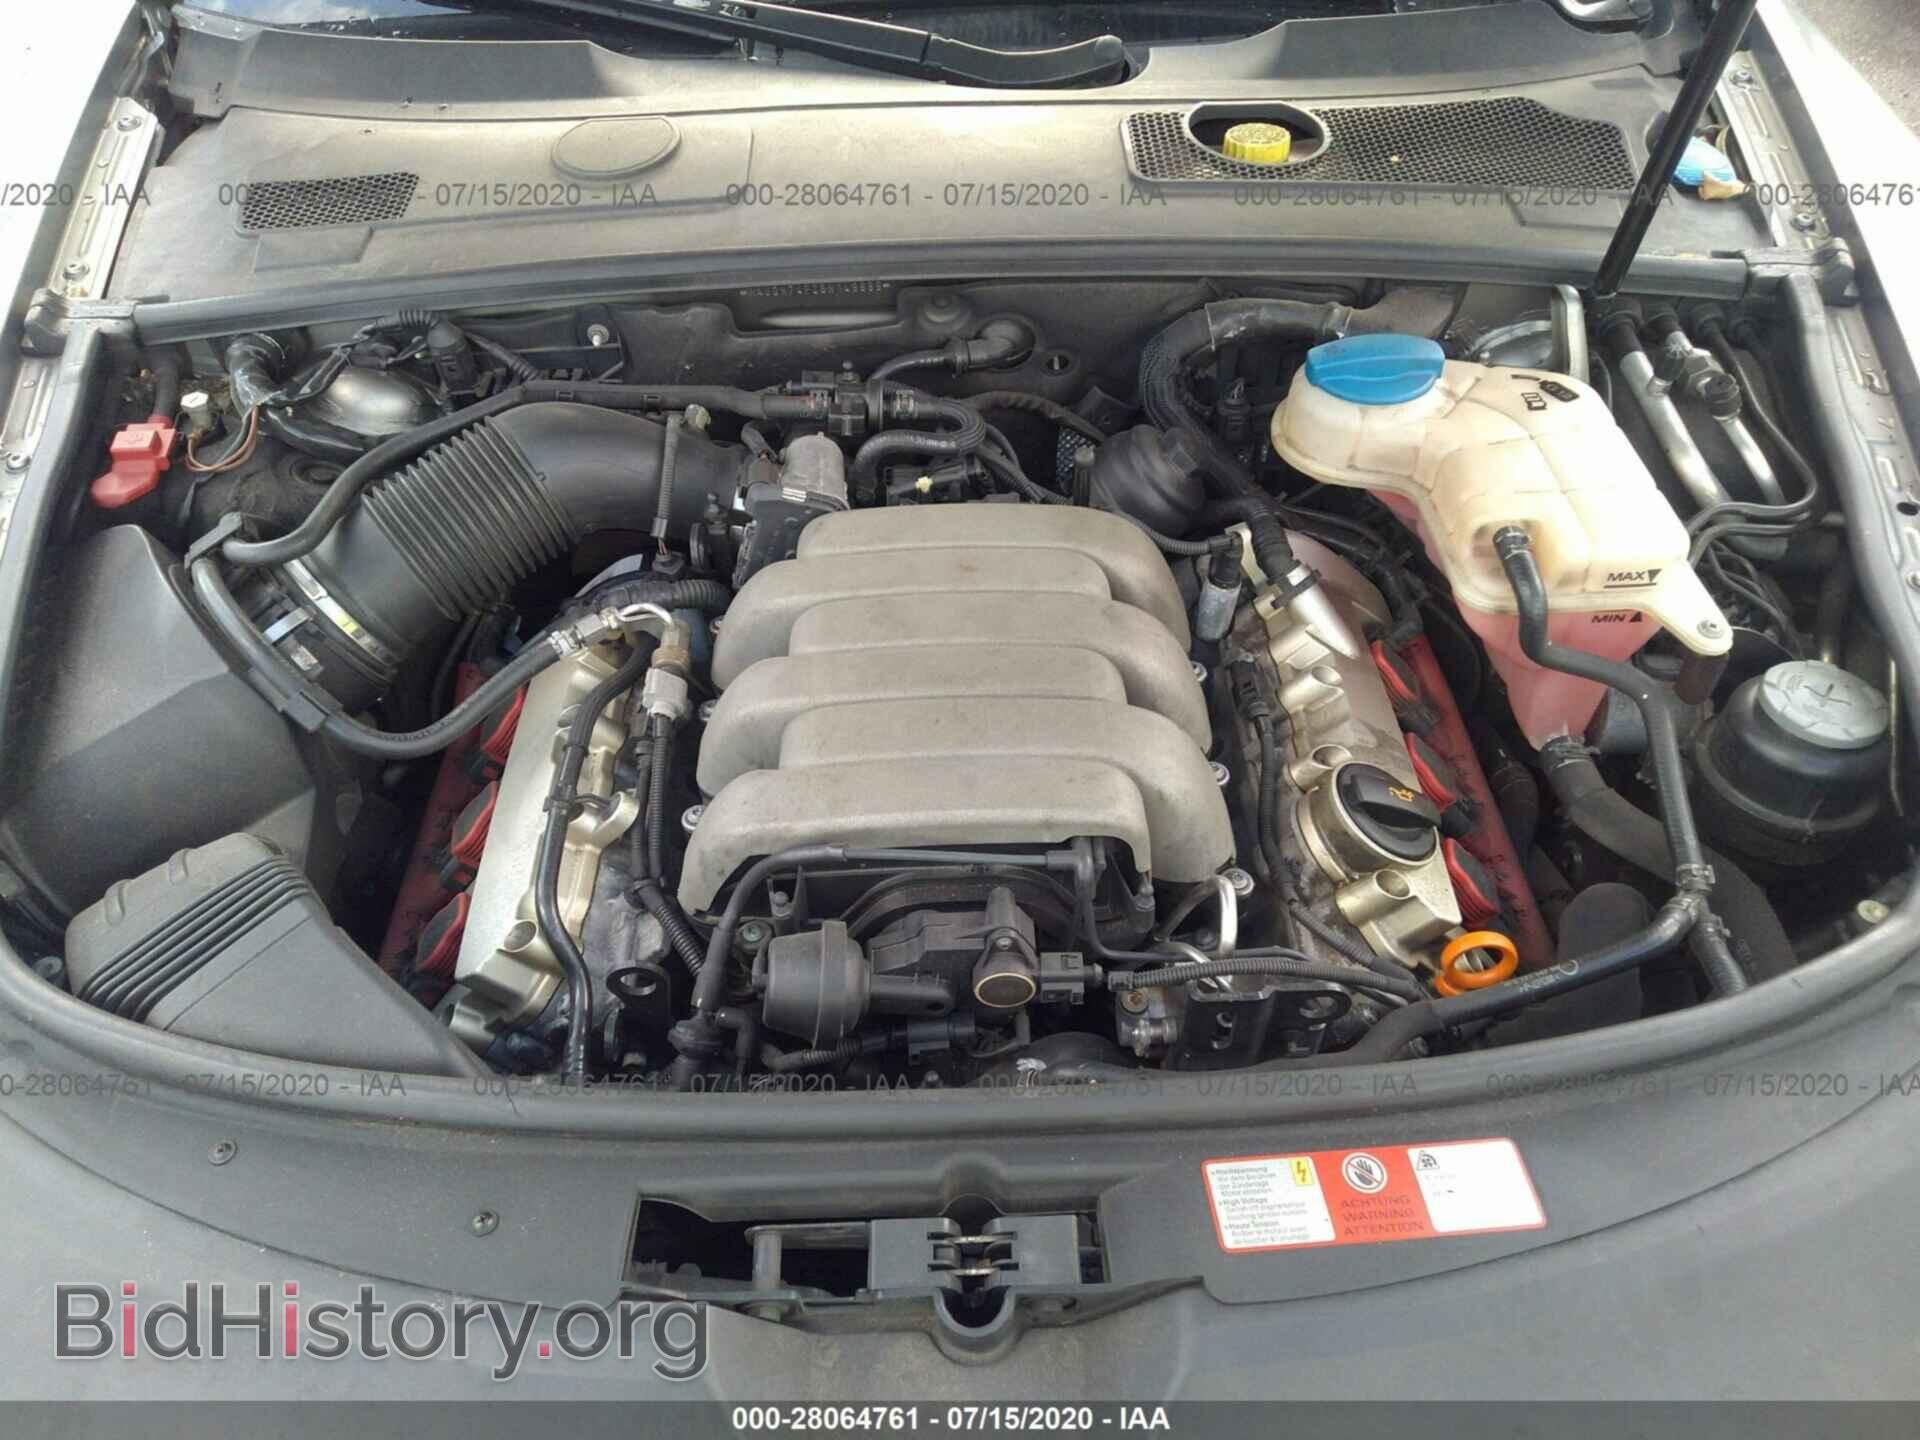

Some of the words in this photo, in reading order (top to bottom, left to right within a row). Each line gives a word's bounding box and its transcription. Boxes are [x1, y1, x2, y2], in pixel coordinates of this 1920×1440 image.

[1607, 571, 1646, 582] MAX
[1591, 613, 1627, 624] MIN
[1344, 1221, 1425, 1236] ATTENTION
